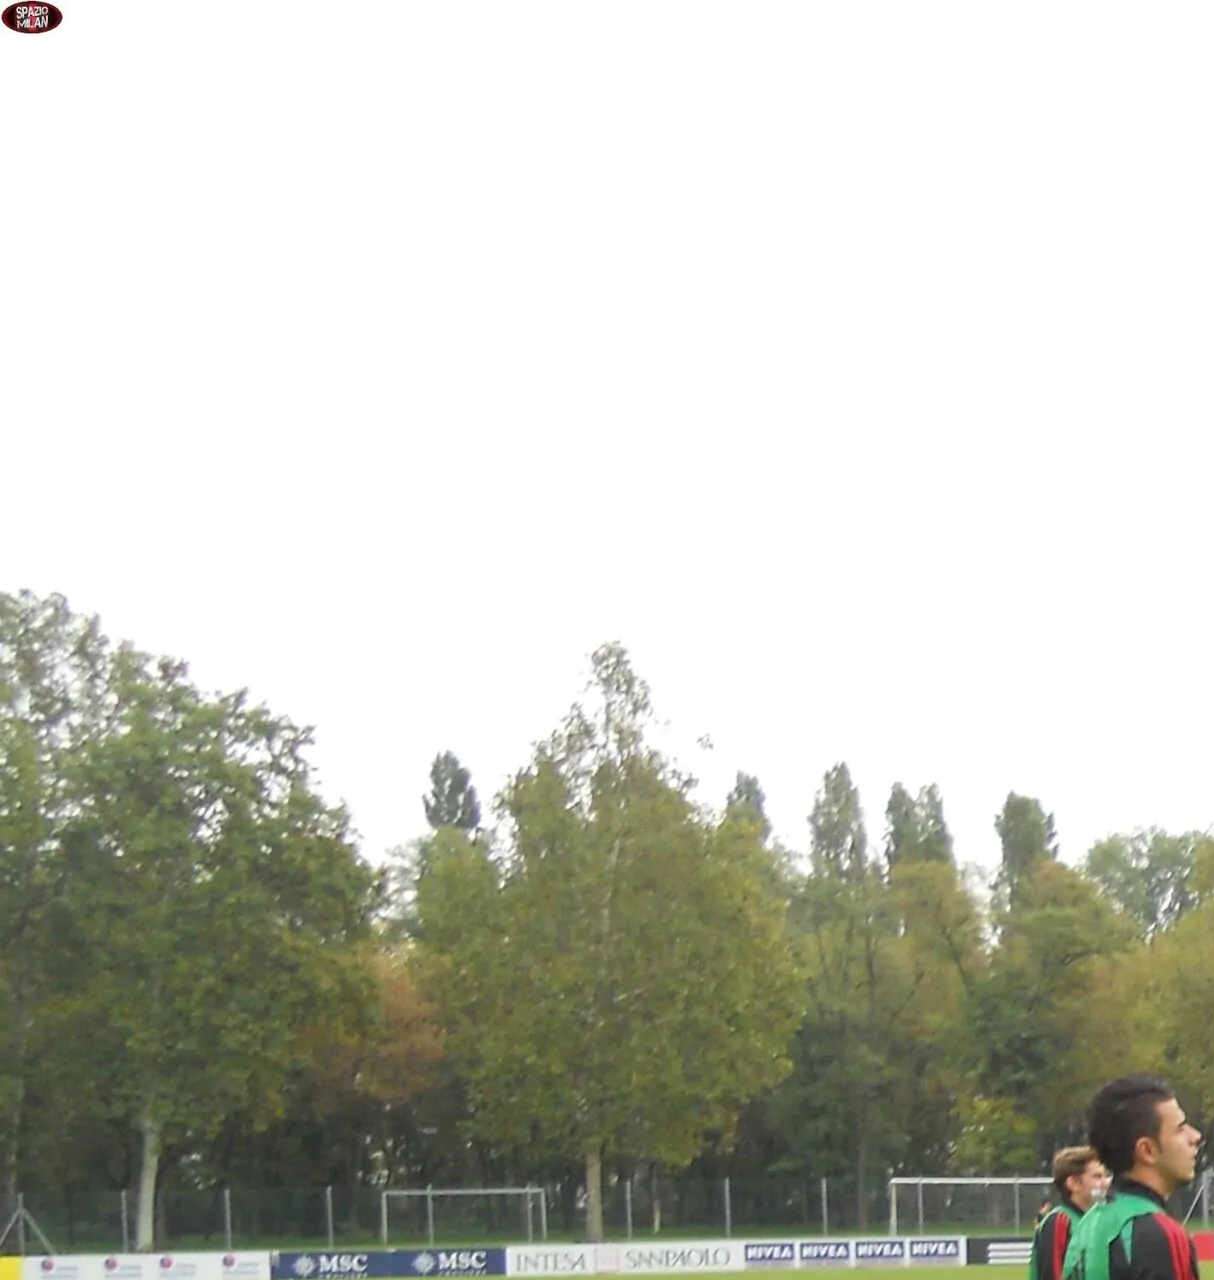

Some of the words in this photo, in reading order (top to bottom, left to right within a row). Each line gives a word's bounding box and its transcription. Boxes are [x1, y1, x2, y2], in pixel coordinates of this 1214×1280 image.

[749, 1246, 793, 1259] NIVEA
[803, 1245, 848, 1258] NIVEA
[857, 1243, 902, 1256] NIVEA
[912, 1242, 957, 1255] NIVEA
[318, 1254, 368, 1272] MSC
[438, 1251, 487, 1269] MSC
[516, 1254, 587, 1272] INTESA
[625, 1248, 731, 1268] SANPAOLO
